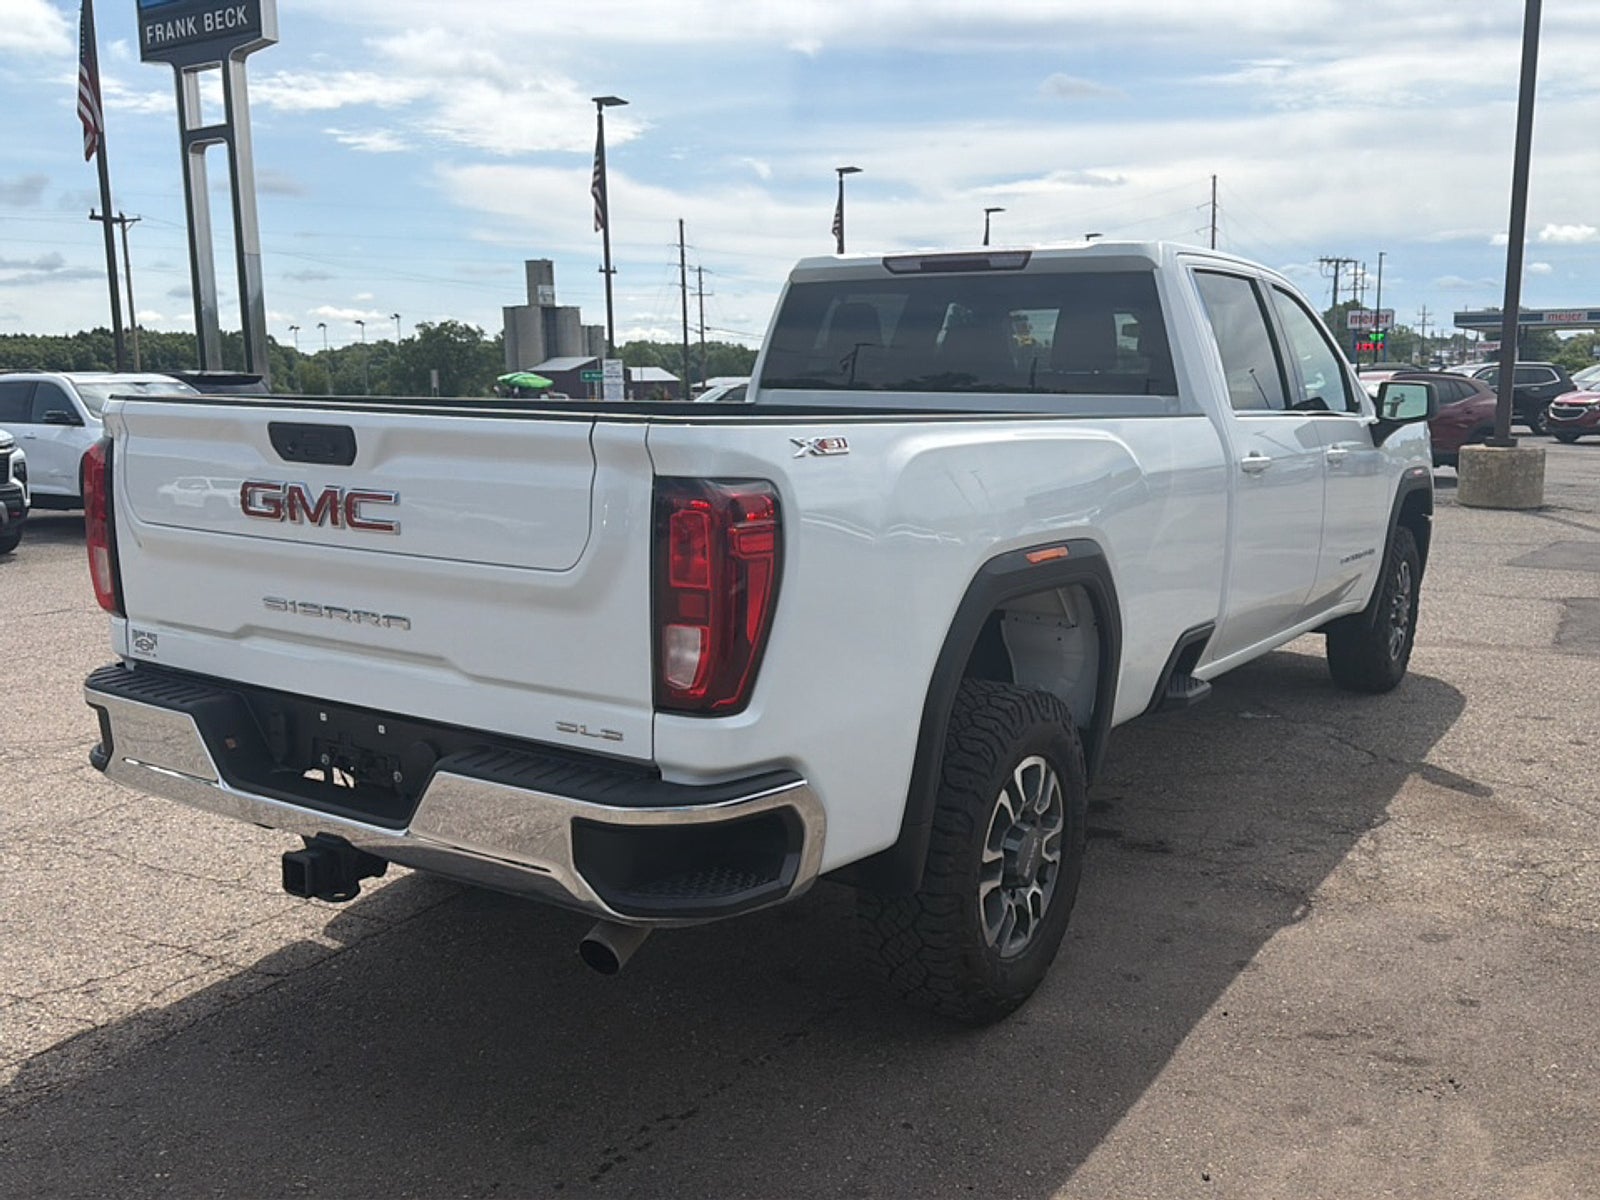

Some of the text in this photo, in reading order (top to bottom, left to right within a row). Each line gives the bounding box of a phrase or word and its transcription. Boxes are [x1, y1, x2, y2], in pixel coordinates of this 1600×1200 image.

[146, 5, 248, 44] FRANK BECK
[1350, 313, 1391, 326] meijer
[1548, 312, 1582, 323] meijer
[240, 479, 401, 536] GMC
[262, 596, 411, 630] SIERRA
